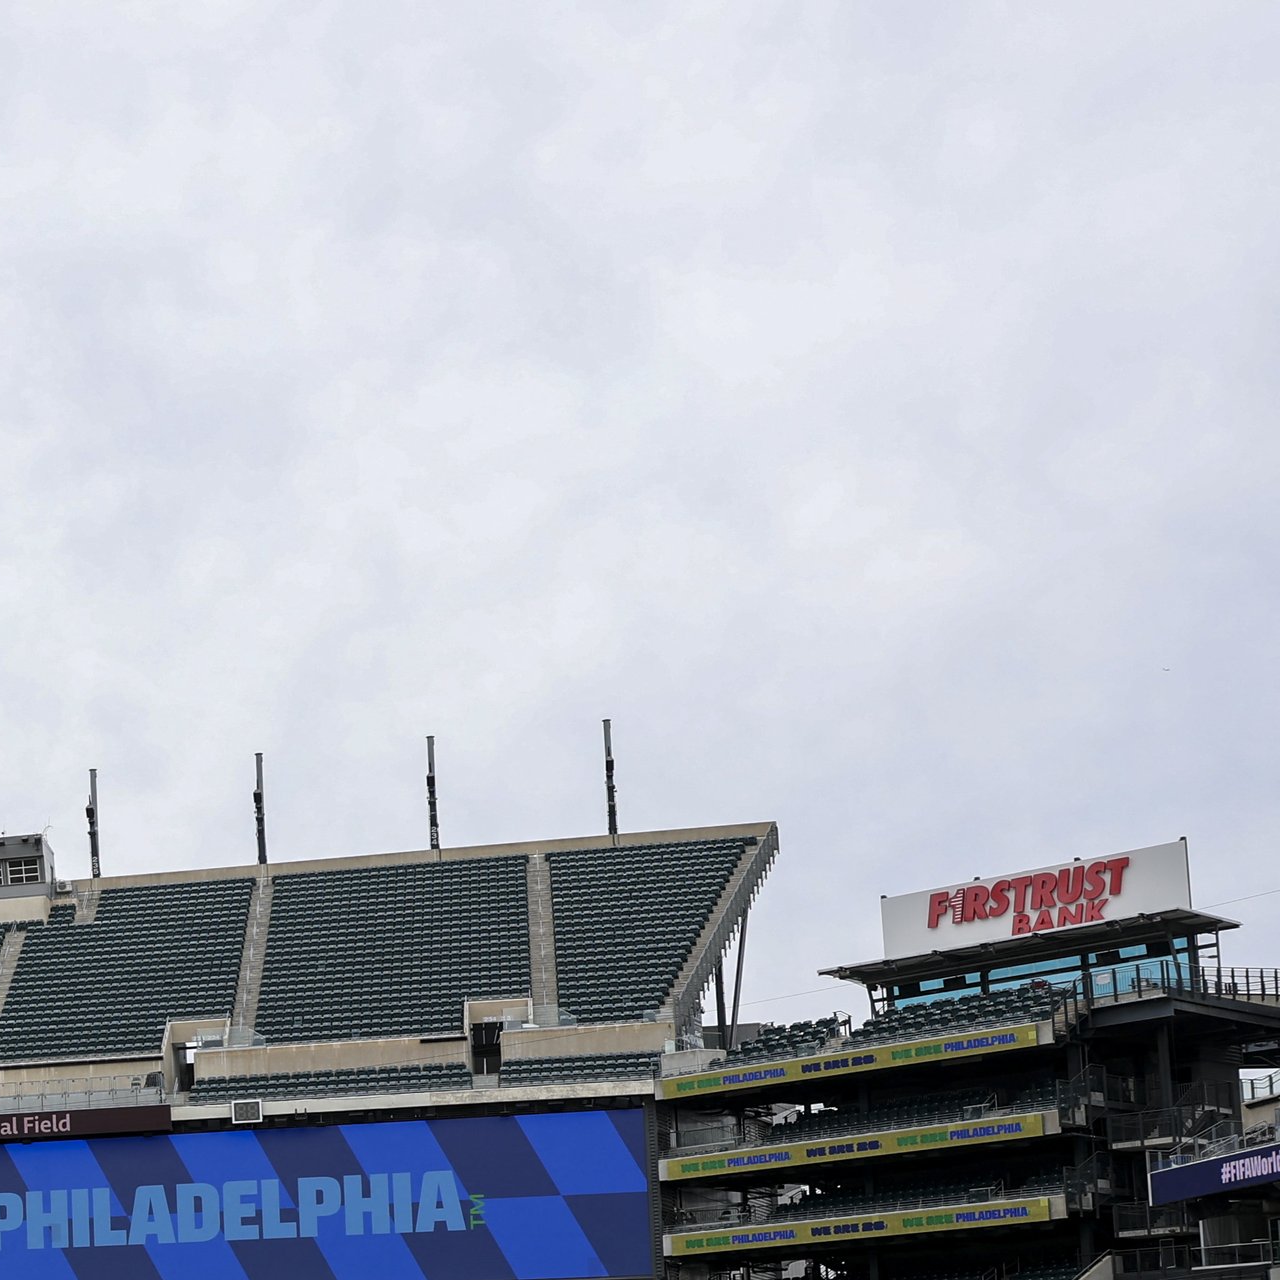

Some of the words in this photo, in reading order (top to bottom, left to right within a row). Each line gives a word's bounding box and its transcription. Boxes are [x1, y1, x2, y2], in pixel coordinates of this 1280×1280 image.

[1012, 898, 1110, 936] BANK
[892, 1047, 913, 1060] WE
[915, 1044, 942, 1058] ARE
[944, 1033, 1016, 1053] PHILADELPHIA
[802, 1062, 822, 1074] WE
[824, 1058, 850, 1072] ARE
[676, 1080, 696, 1092] WE
[697, 1076, 721, 1090] ARE
[723, 1068, 786, 1086] PHILADELPHIA
[24, 1113, 71, 1135] Field
[897, 1134, 918, 1147] WE
[920, 1131, 948, 1145] ARE
[950, 1122, 1022, 1142] PHILADELPHIA
[806, 1146, 826, 1158] WE
[828, 1143, 854, 1156] ARE
[681, 1162, 700, 1174] WE
[702, 1158, 726, 1171] ARE
[728, 1151, 790, 1168] PHILADELPHIA
[902, 1216, 924, 1228] WE
[927, 1212, 954, 1226] ARE
[956, 1206, 1028, 1223] PHILADELPHIA
[686, 1236, 704, 1249] WE
[706, 1234, 730, 1247] ARE
[732, 1230, 795, 1244] PHILADELPHIA
[811, 1224, 832, 1236] WE
[833, 1222, 858, 1234] ARE
